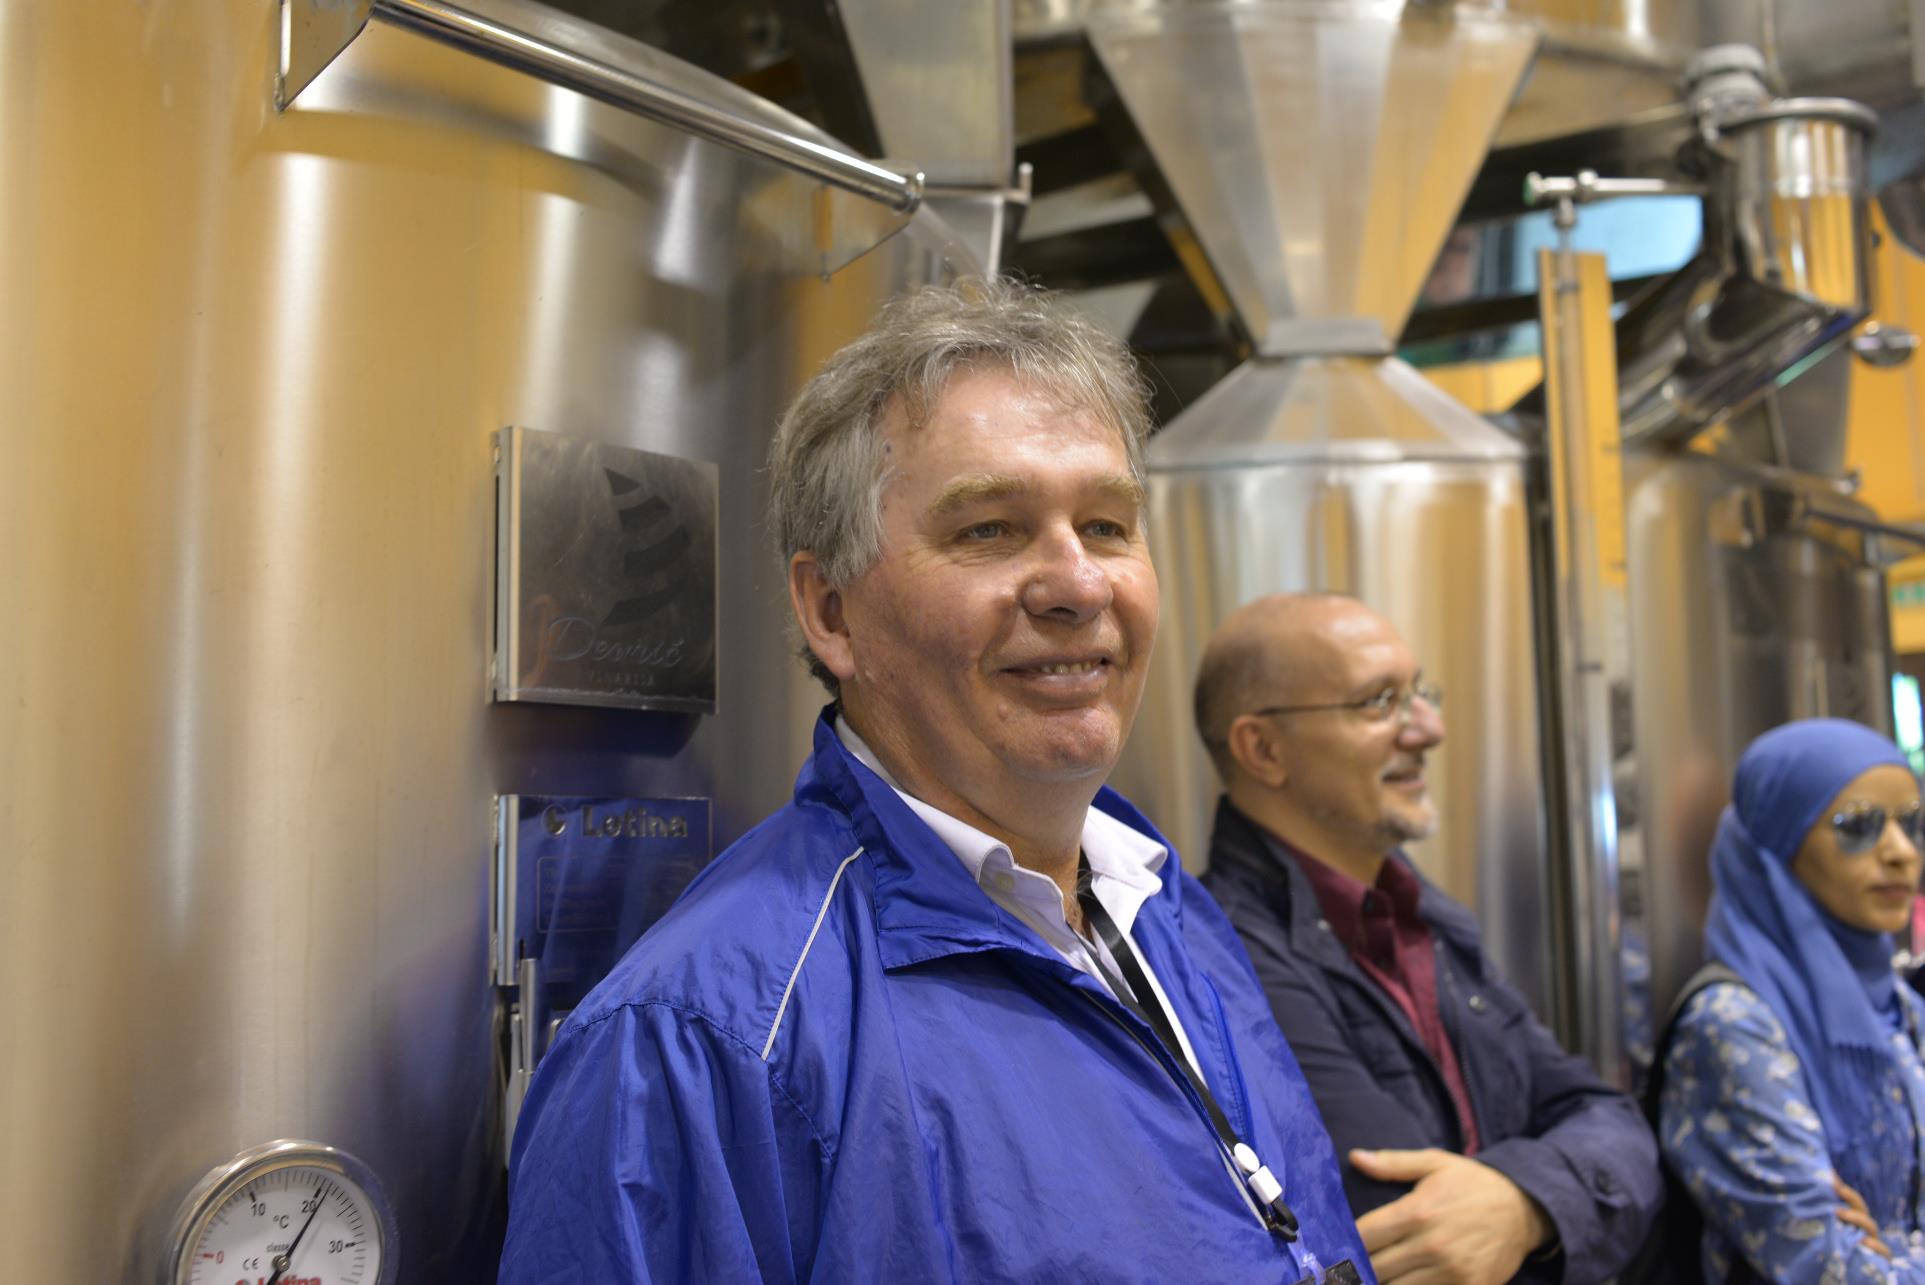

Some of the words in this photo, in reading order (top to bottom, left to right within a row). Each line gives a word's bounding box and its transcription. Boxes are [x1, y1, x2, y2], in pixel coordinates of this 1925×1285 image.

[582, 805, 689, 838] Letina
[250, 1202, 267, 1217] 10
[301, 1200, 318, 1214] 20
[328, 1240, 344, 1254] 30
[215, 1250, 225, 1265] 0
